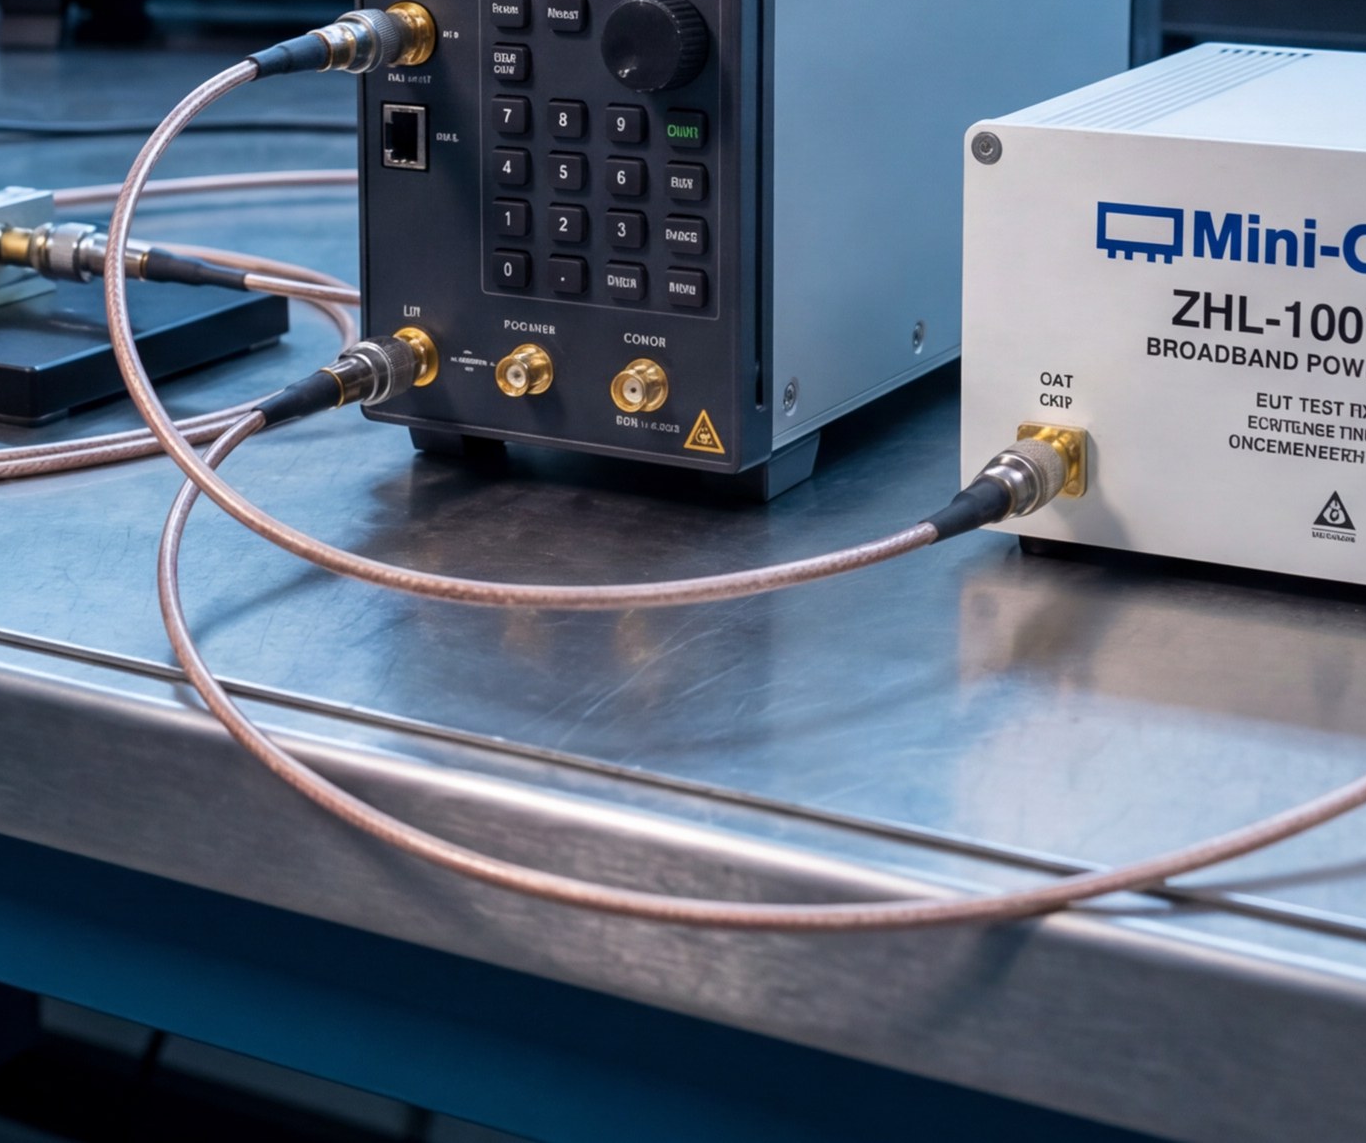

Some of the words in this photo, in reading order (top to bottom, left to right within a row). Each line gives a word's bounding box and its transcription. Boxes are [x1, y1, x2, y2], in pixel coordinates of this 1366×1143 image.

[502, 108, 512, 123] 7
[558, 112, 568, 127] 8
[616, 117, 626, 132] 9
[502, 160, 512, 174] 4
[559, 164, 568, 179] 5
[616, 170, 626, 185] 6
[504, 211, 511, 226] 1
[559, 217, 568, 232] 2
[617, 222, 626, 237] 3
[503, 262, 512, 276] 0
[1146, 337, 1299, 370] BROADBAND
[1040, 371, 1074, 389] OAT
[1256, 392, 1293, 411] EUT
[1299, 397, 1345, 417] TEST
